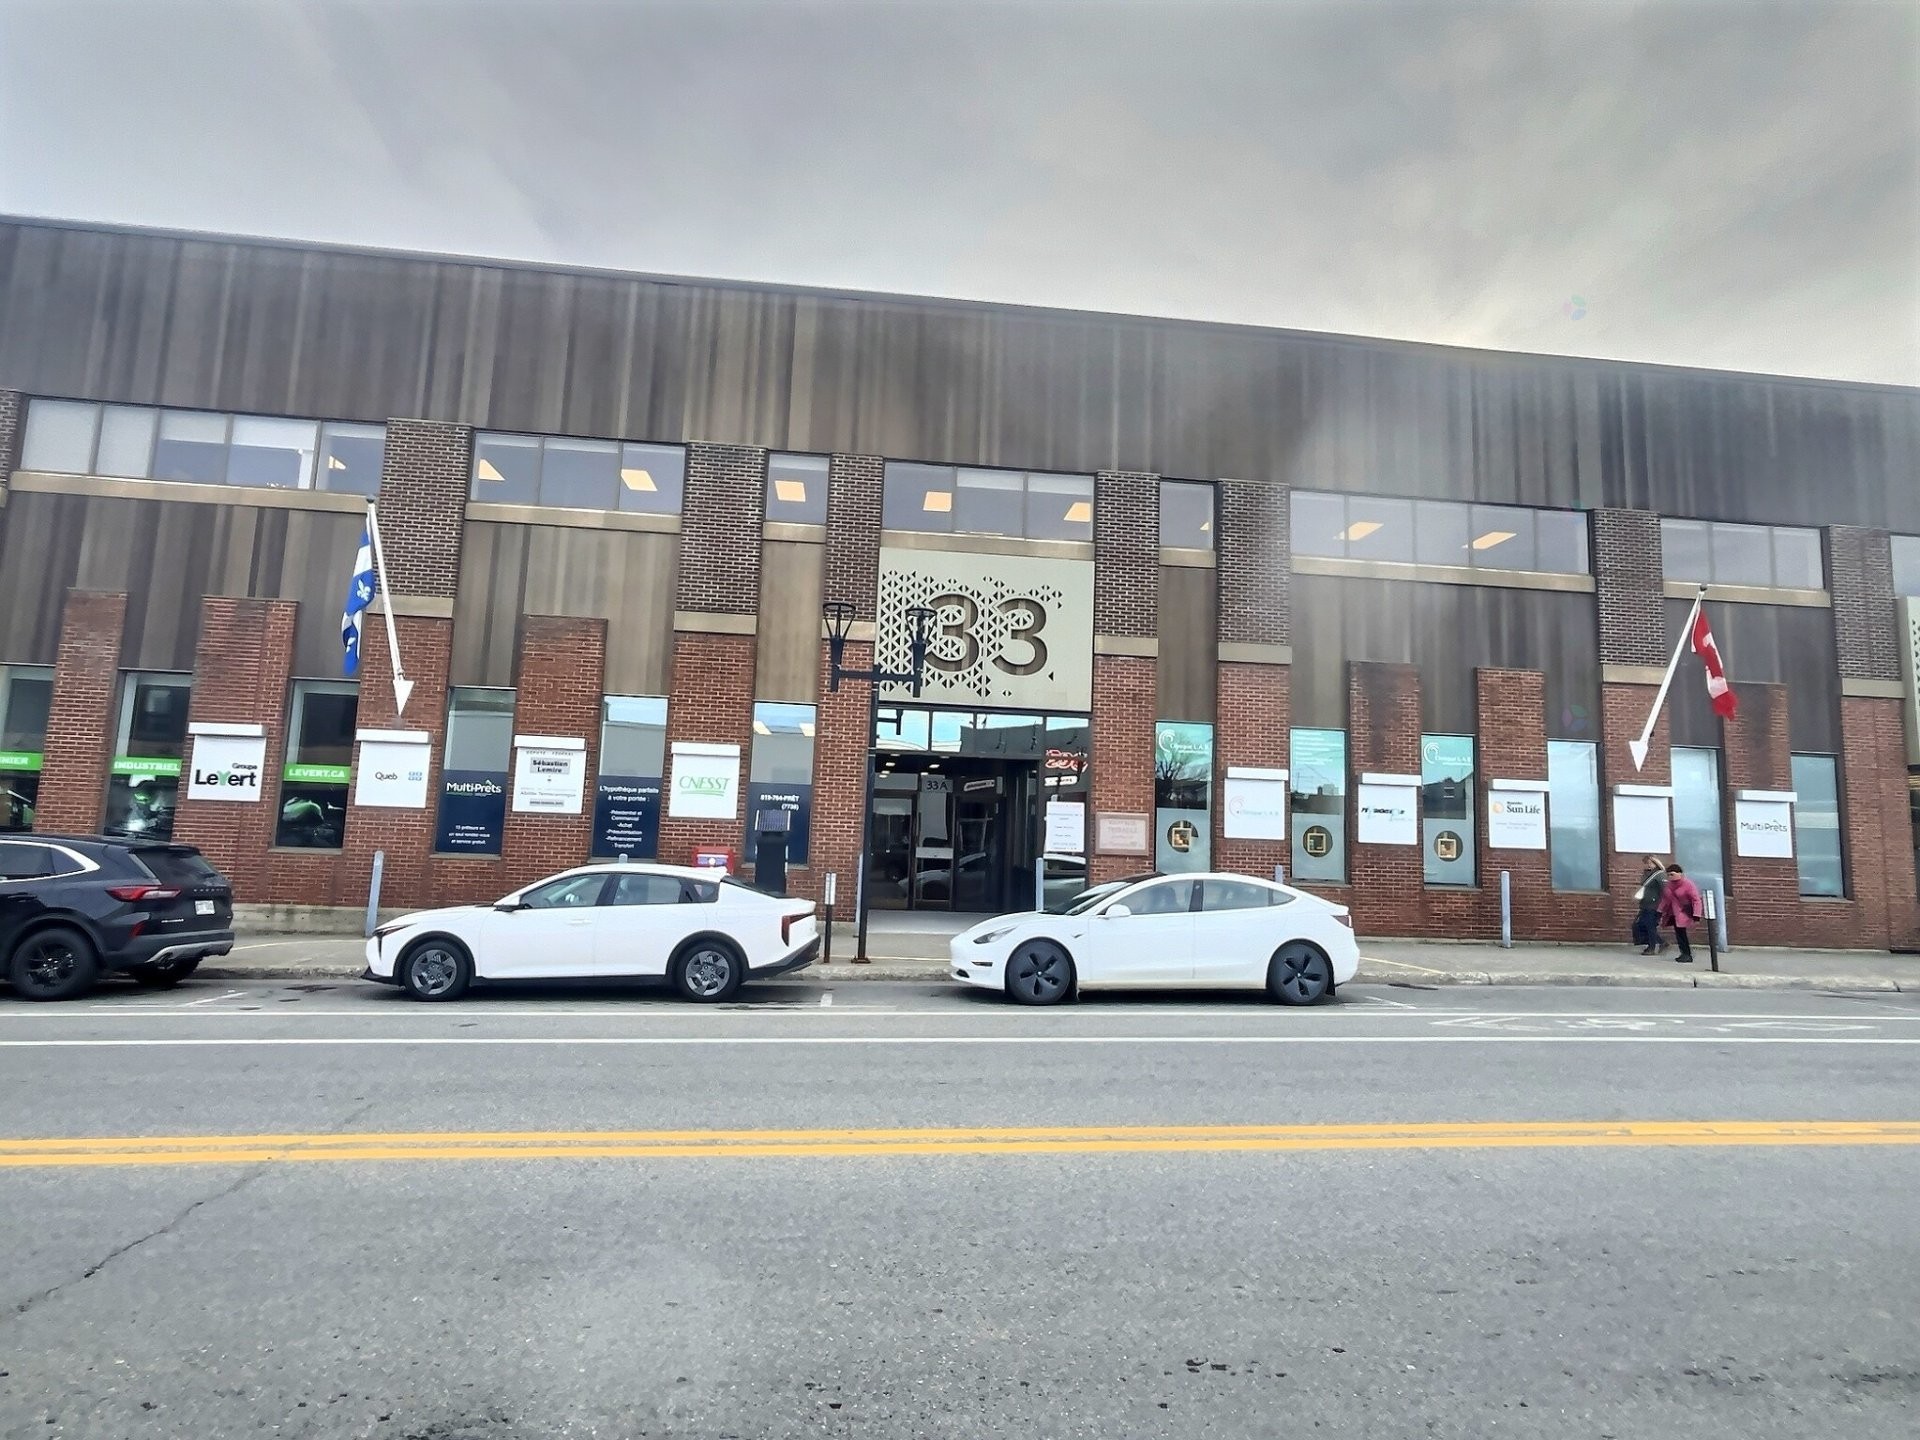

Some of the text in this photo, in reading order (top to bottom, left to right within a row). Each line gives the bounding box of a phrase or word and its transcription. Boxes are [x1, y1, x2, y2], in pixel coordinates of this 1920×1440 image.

[923, 593, 1048, 676] 33
[289, 768, 345, 779] LEVERT.CA
[680, 776, 731, 790] CNESST
[1506, 805, 1541, 814] Sun Life
